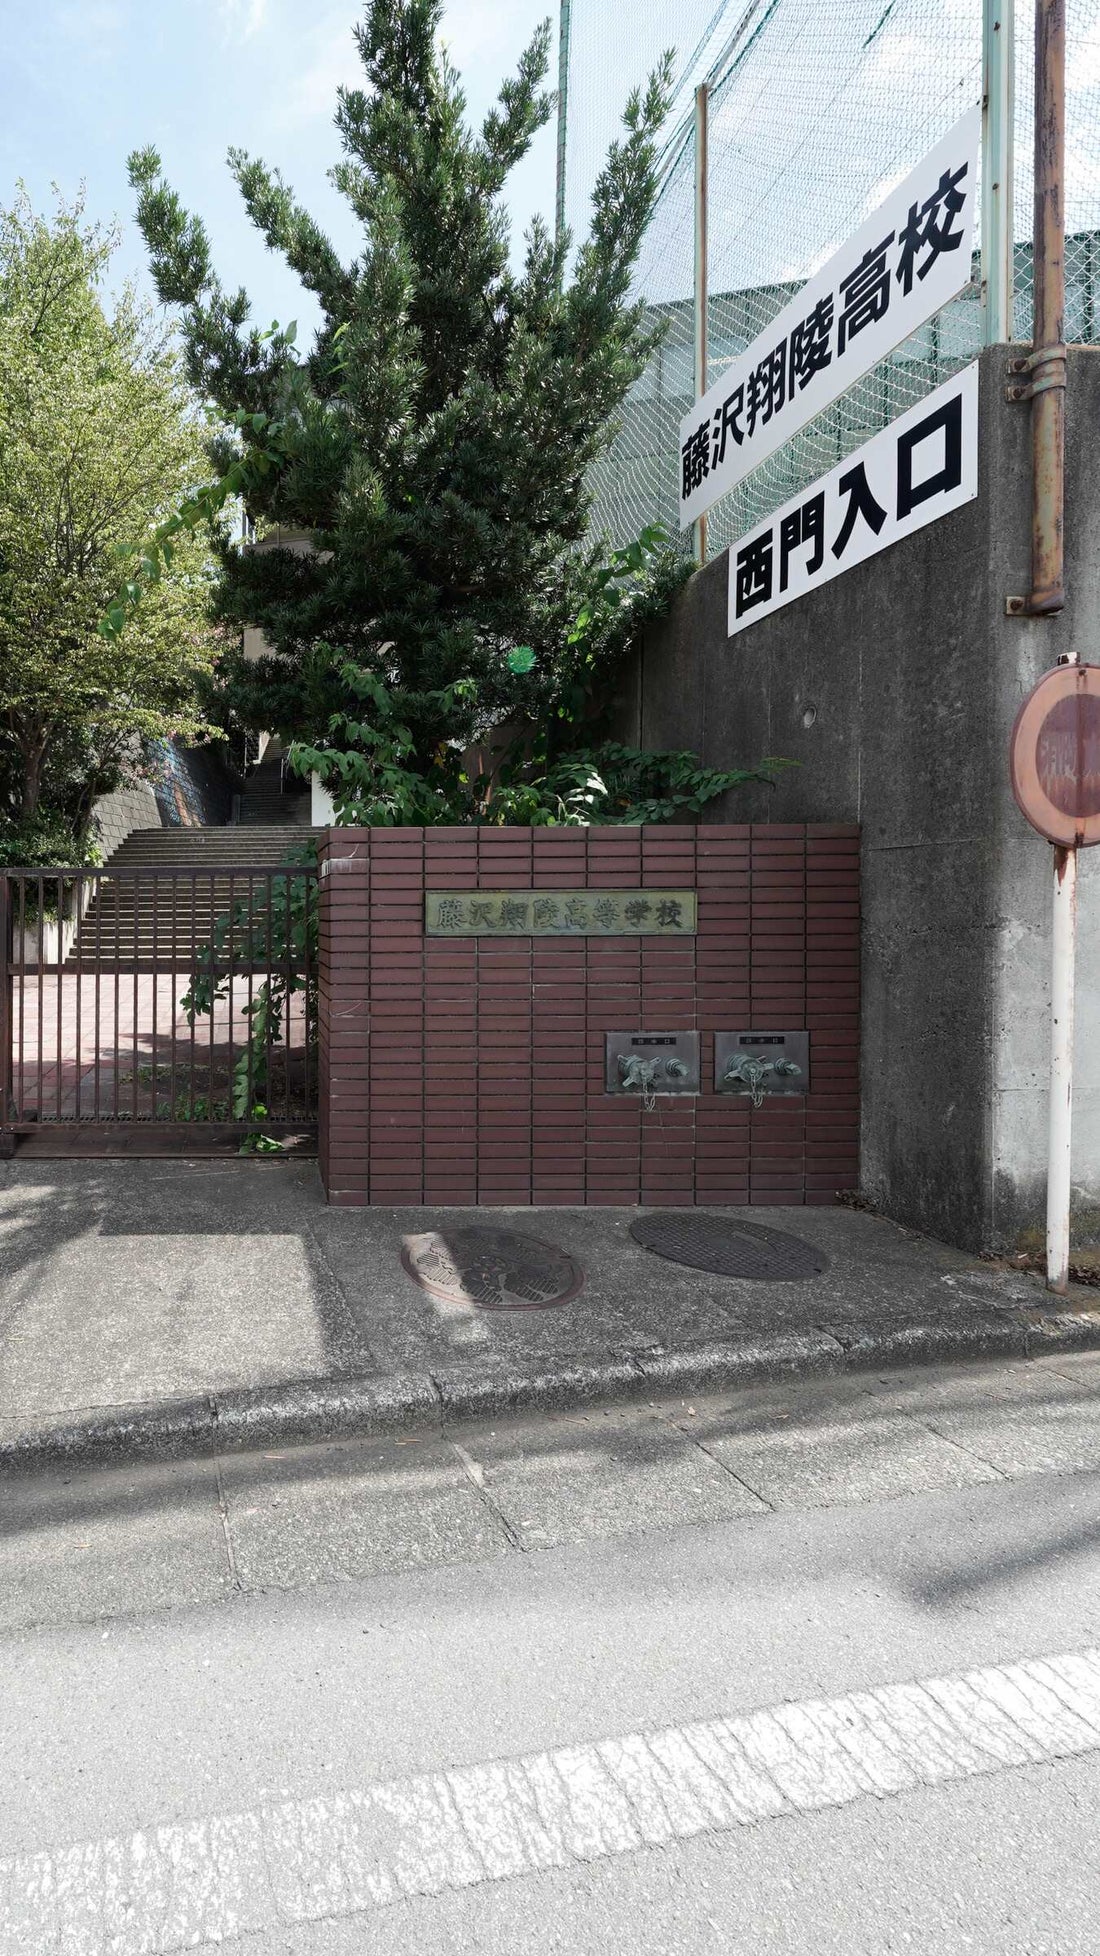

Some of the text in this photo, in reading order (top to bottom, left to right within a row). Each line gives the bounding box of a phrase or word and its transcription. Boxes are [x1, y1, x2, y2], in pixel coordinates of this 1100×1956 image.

[681, 160, 969, 500] 藤沢翔陵高校
[735, 393, 963, 620] 西門入口
